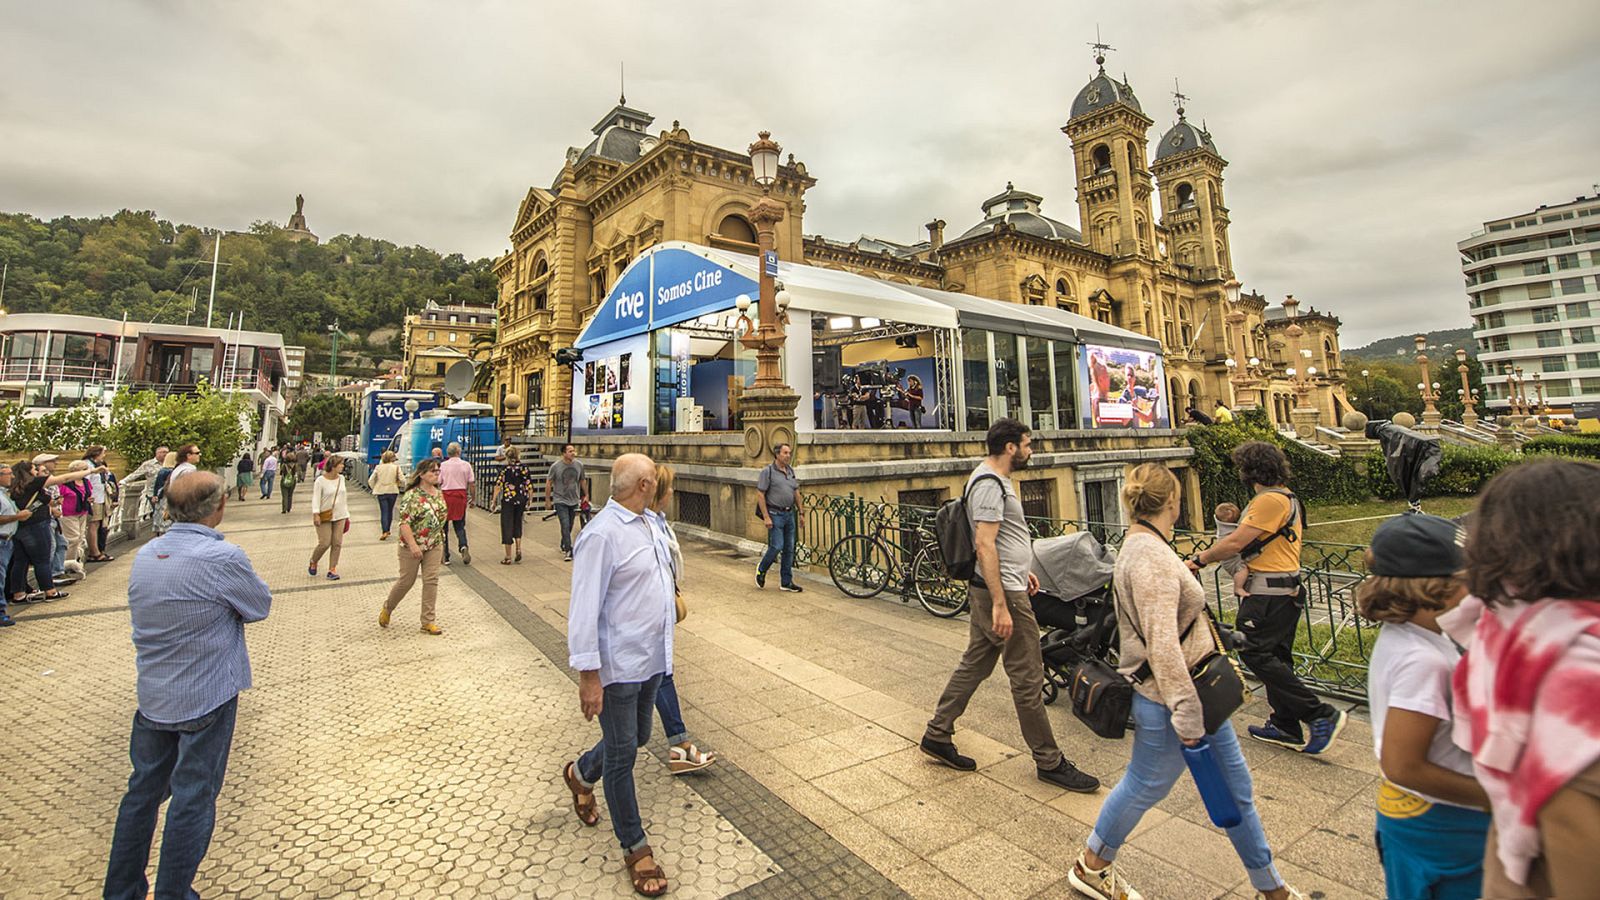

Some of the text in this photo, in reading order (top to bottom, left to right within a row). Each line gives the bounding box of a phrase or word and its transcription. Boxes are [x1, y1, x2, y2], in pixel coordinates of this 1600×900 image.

[658, 269, 722, 305] Somos Cine
[615, 291, 644, 319] rtve
[376, 404, 403, 420] tve
[430, 425, 444, 442] tve
